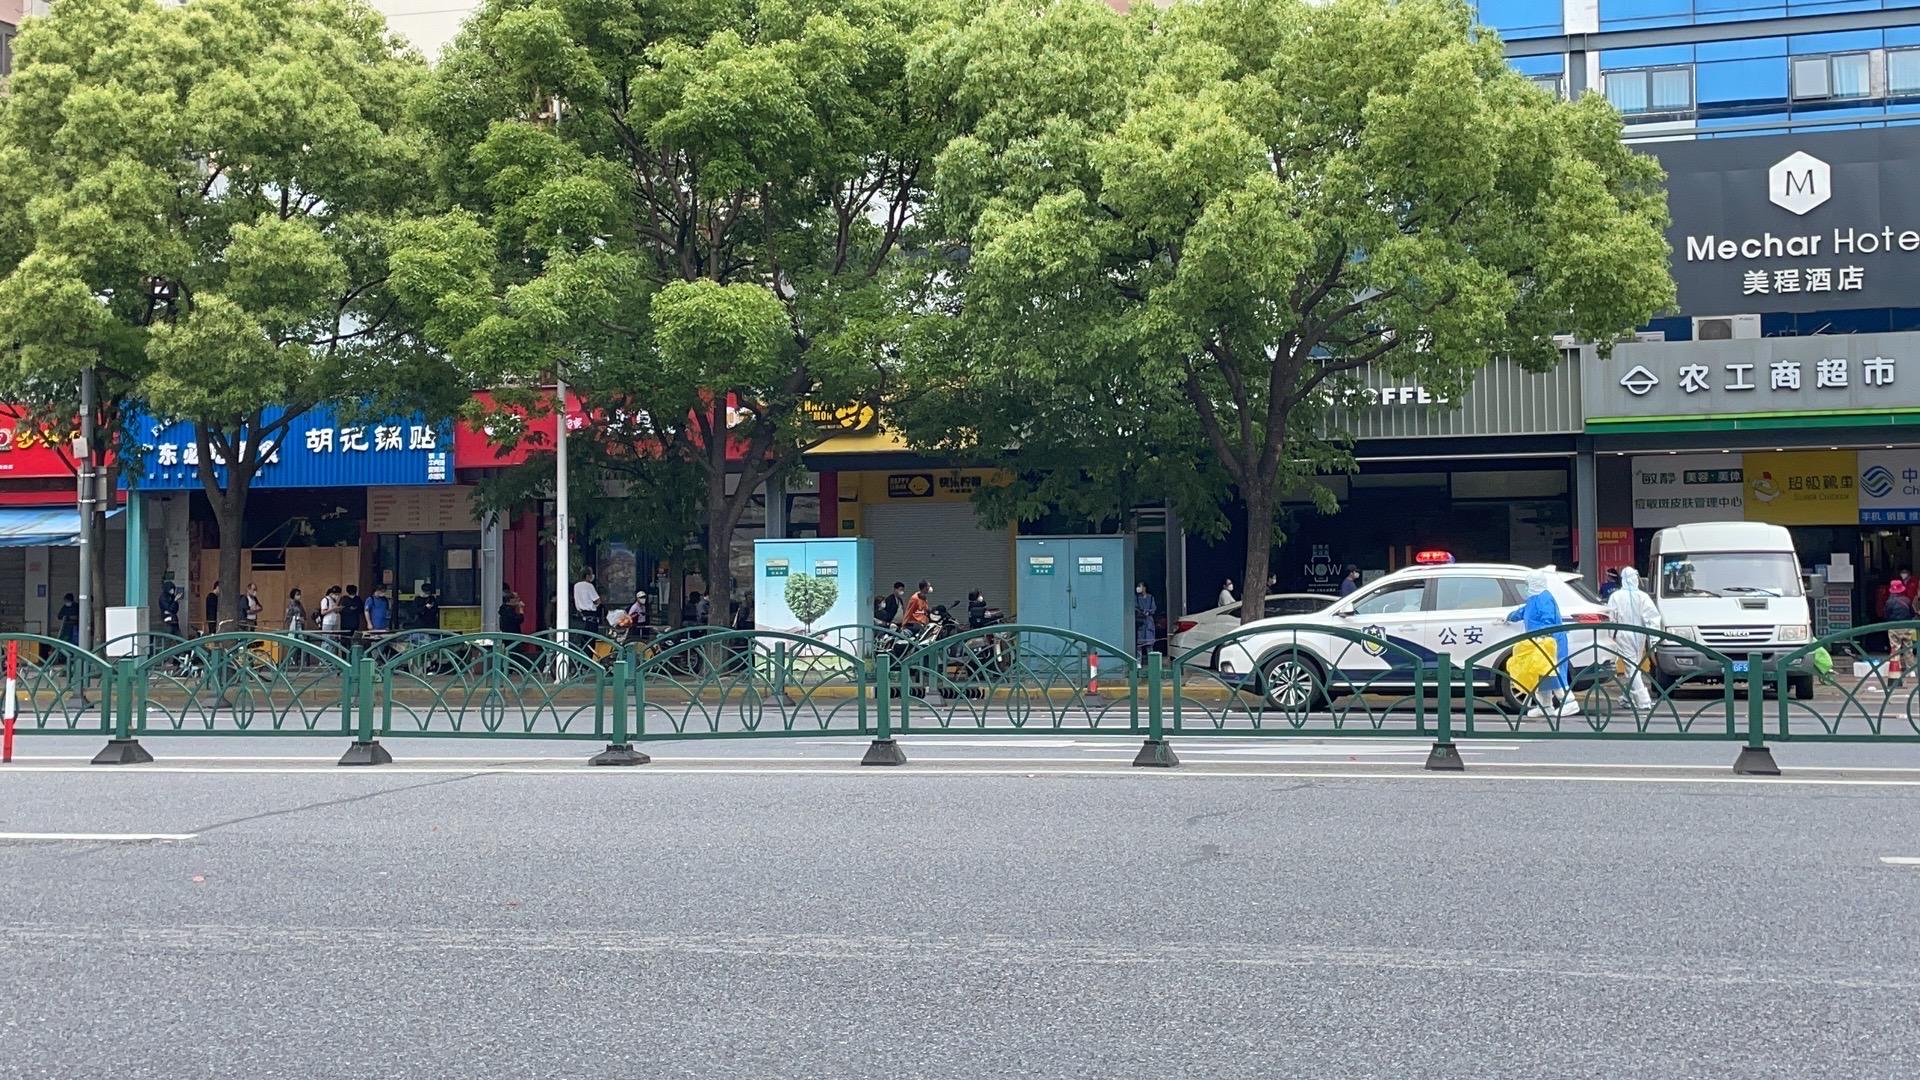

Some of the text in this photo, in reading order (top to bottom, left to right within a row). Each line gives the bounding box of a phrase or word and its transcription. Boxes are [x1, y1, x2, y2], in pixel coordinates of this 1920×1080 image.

[1785, 169, 1815, 196] M
[1686, 231, 1822, 262] Mechar
[1743, 264, 1865, 295] 美程酒店
[1679, 356, 1895, 394] 农工商超市
[305, 424, 436, 453] 胡记锅贴
[1438, 625, 1484, 645] 公安
